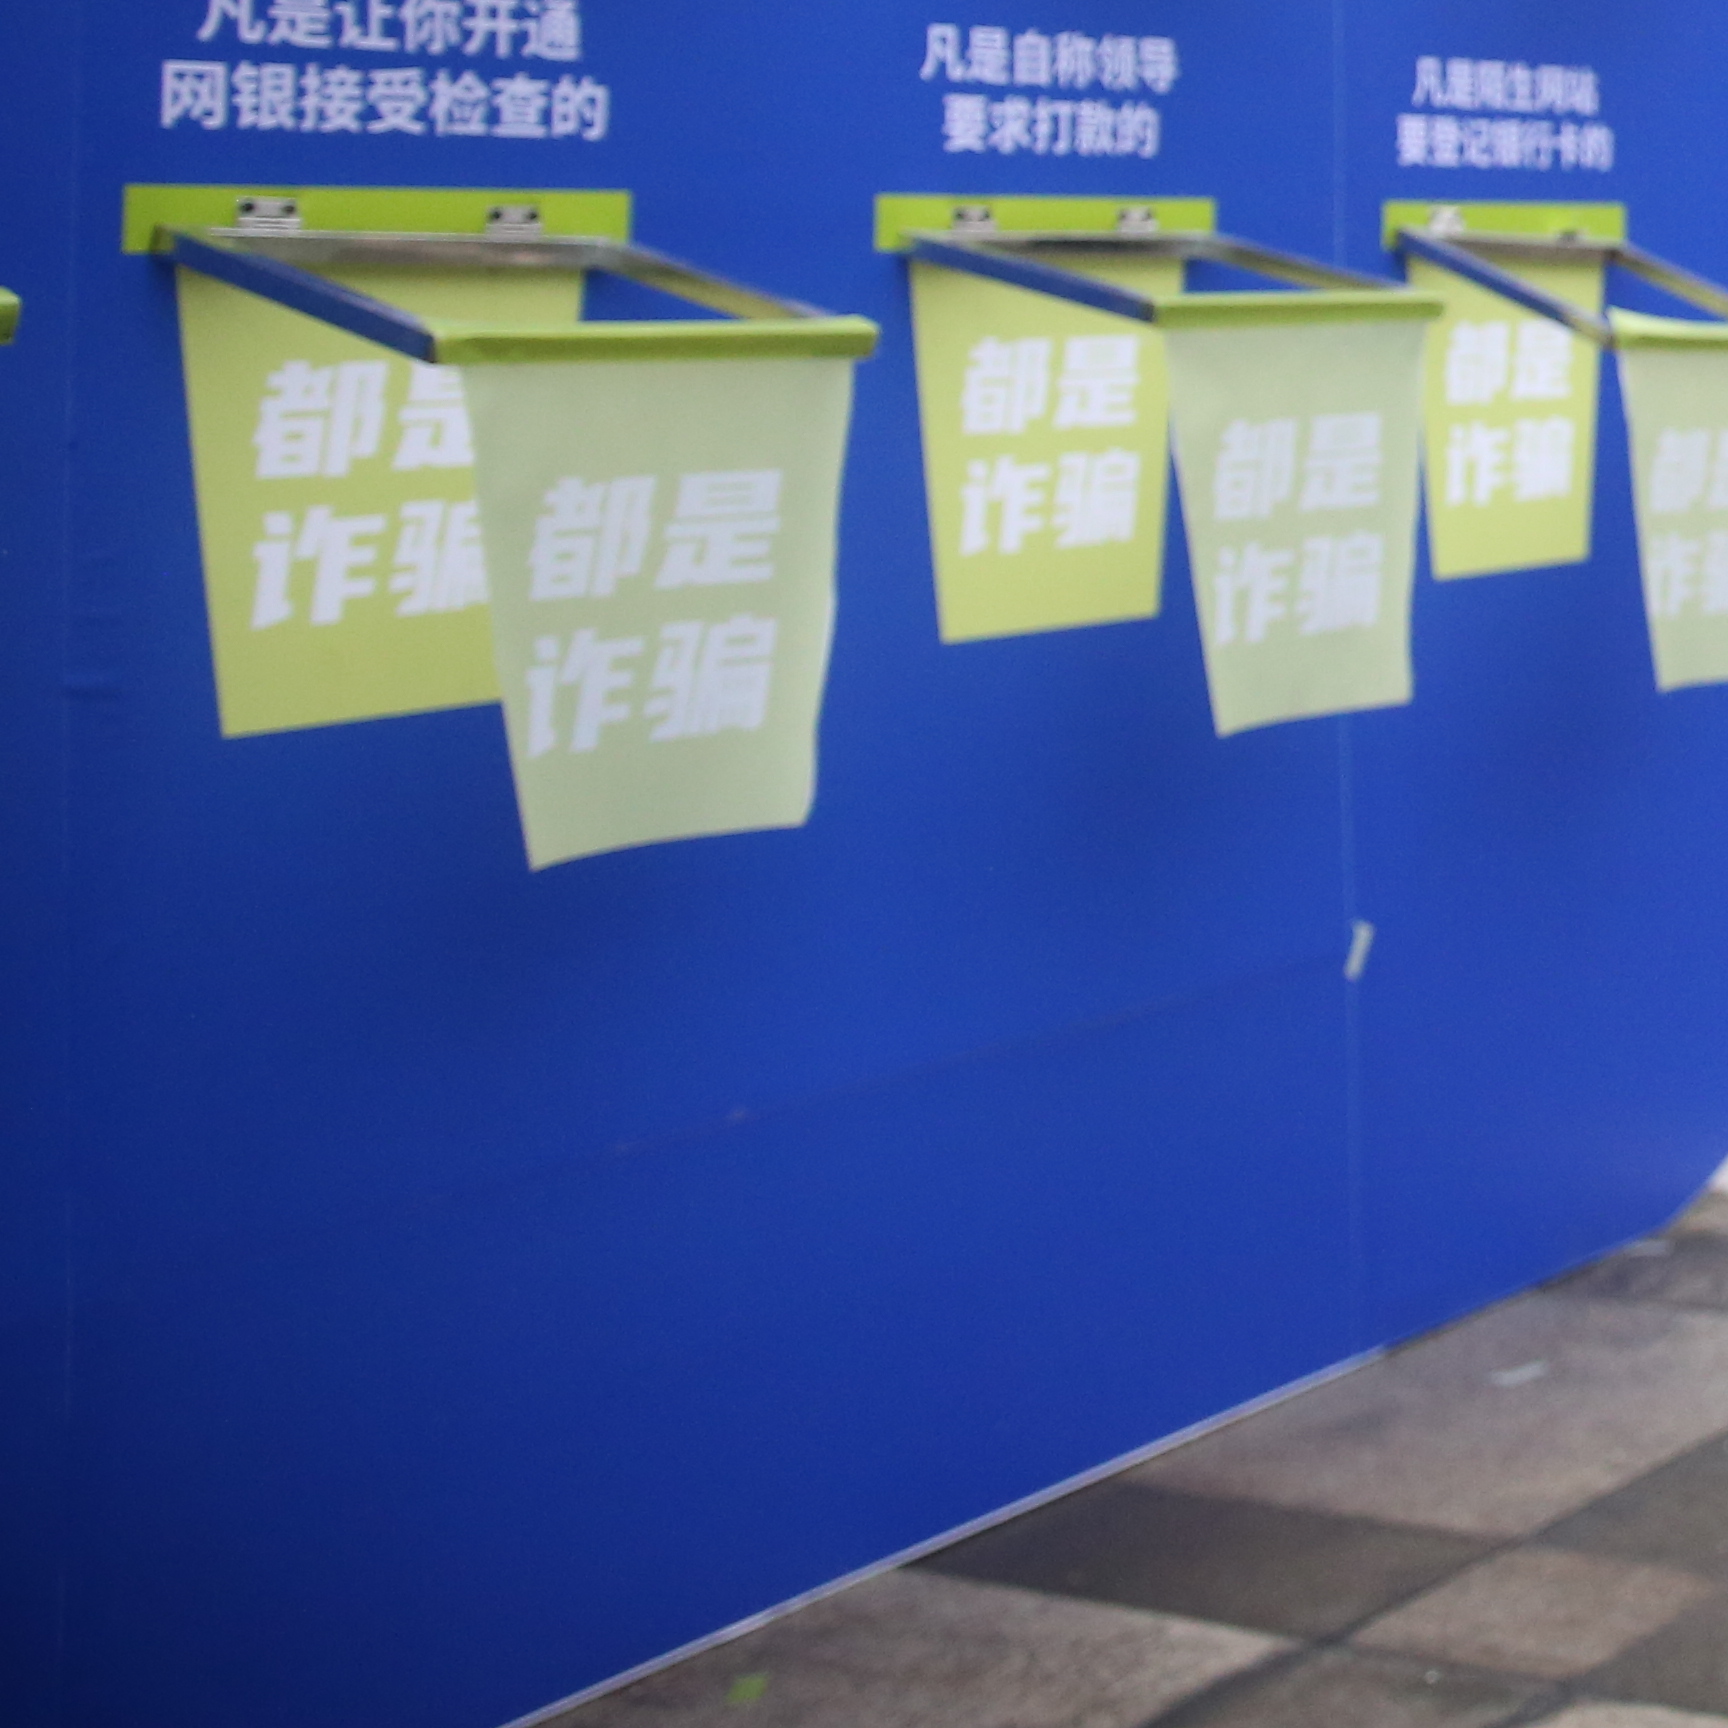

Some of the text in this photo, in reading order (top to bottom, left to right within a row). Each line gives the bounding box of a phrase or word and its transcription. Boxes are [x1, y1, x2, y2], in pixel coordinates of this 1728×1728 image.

[161, 59, 609, 141] 网银接受检查的
[918, 21, 1181, 96] 凡是自称领导
[940, 92, 1162, 159] 要求打款的
[960, 334, 1141, 435] 都是
[1446, 320, 1574, 405] 都是
[251, 360, 476, 480] 都是
[1213, 412, 1383, 522] 都是
[1446, 418, 1575, 507] 诈骗
[528, 469, 783, 602] 都是
[958, 448, 1142, 557] 诈骗
[250, 498, 492, 631] 诈骗
[1211, 532, 1384, 648] 诈骗
[524, 614, 779, 759] 诈骗
